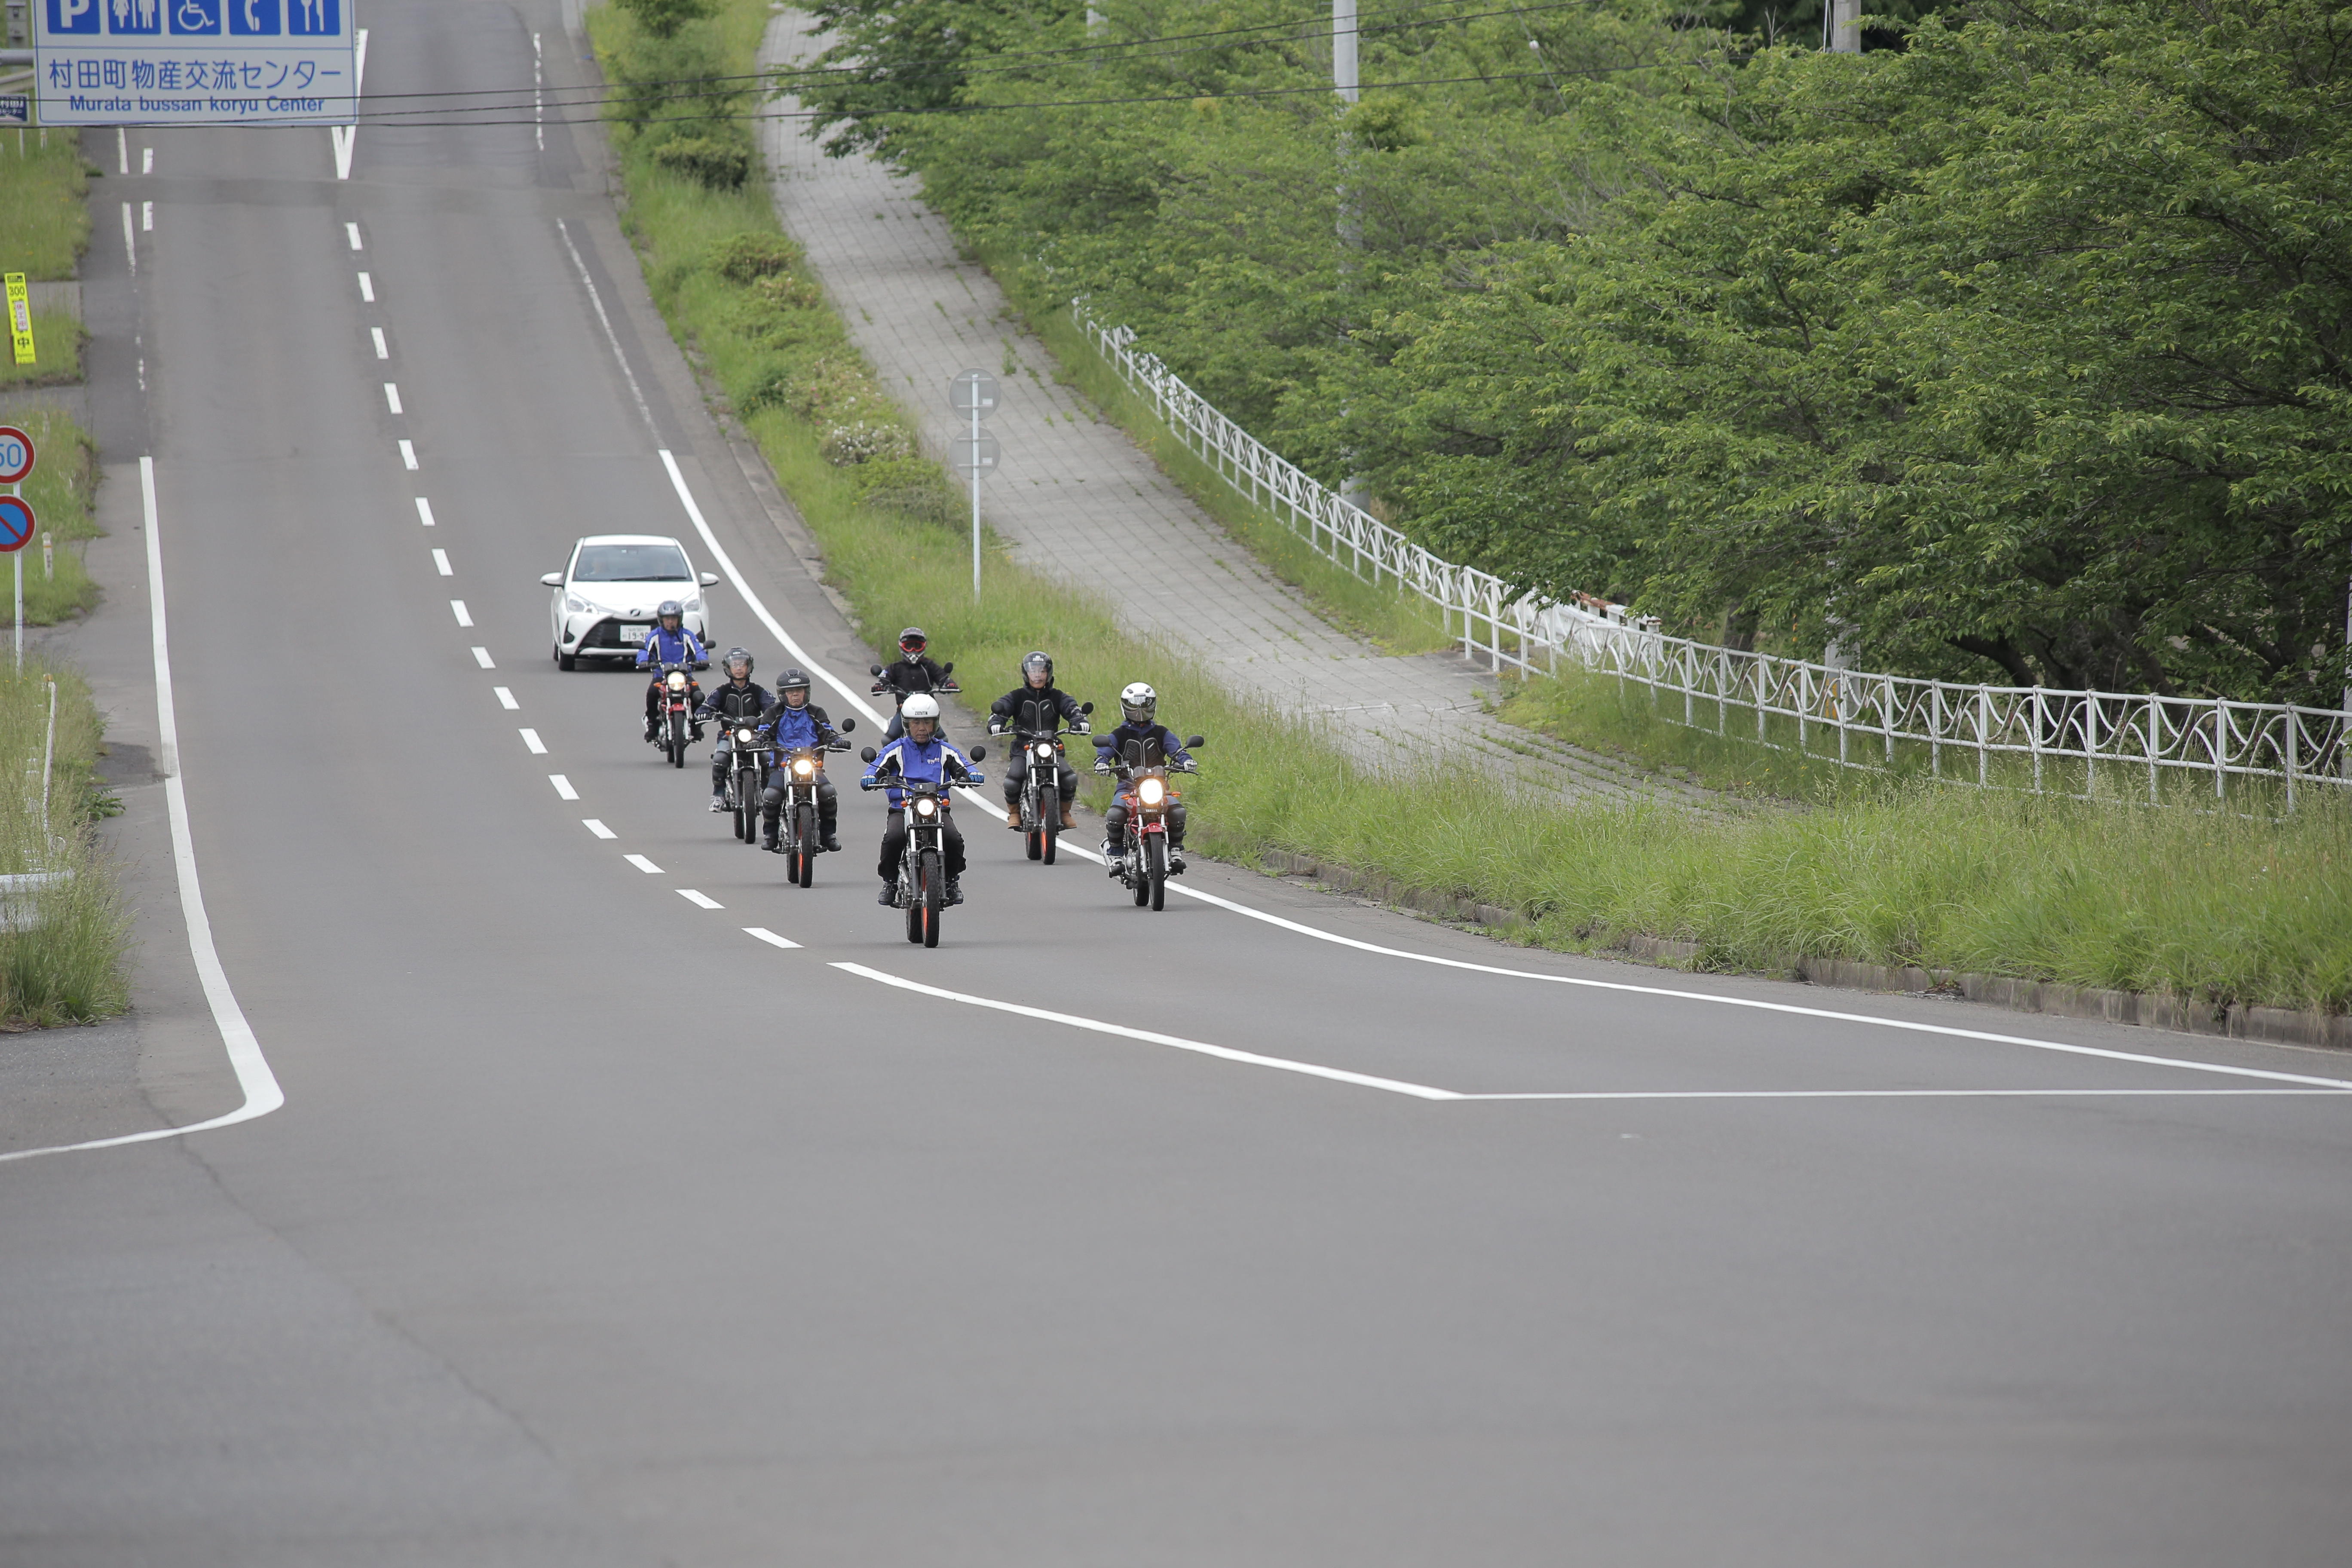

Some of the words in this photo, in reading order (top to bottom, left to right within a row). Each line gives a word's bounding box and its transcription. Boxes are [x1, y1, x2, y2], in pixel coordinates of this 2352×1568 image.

[49, 59, 341, 89] 村田町物産交流センター
[70, 95, 132, 111] Murata
[140, 95, 202, 111] bussan
[210, 95, 258, 115] koryu
[266, 96, 325, 111] Center
[9, 286, 24, 296] 300
